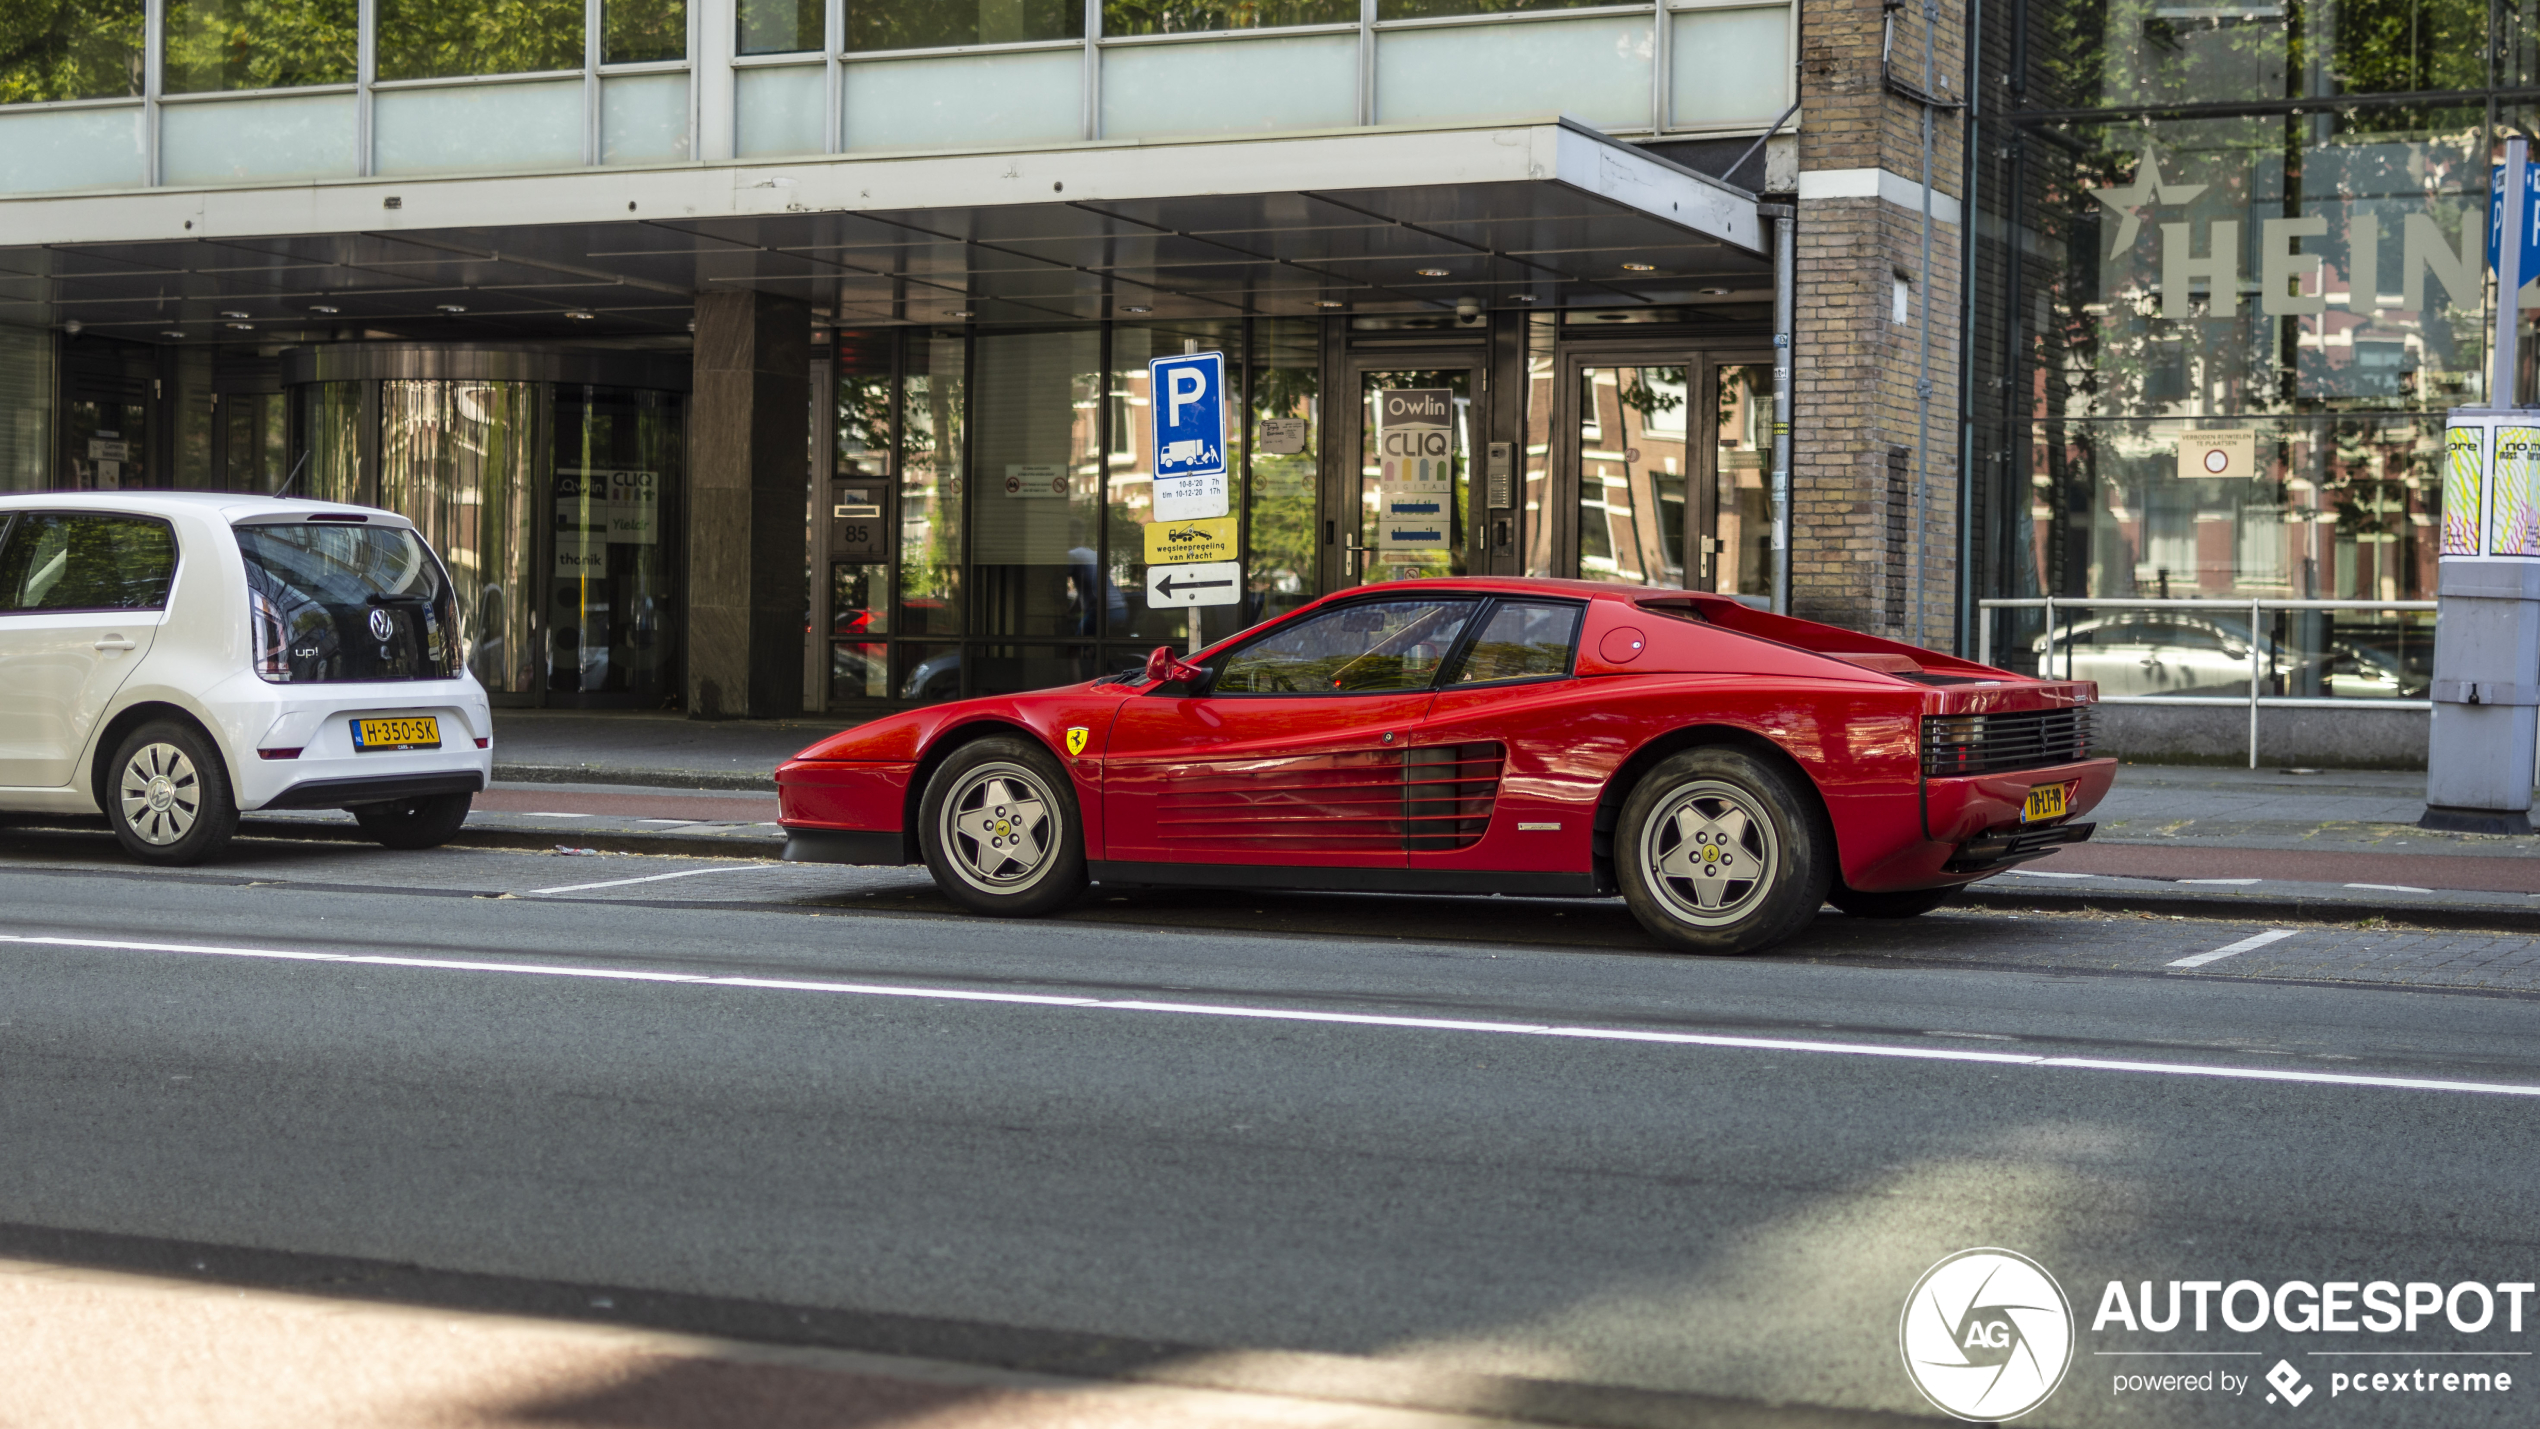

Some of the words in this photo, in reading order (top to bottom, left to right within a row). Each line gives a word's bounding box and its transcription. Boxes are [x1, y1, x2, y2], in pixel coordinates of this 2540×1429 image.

[2159, 210, 2540, 318] HEIN
[1168, 366, 1207, 428] P
[1388, 394, 1446, 416] Owlin
[1385, 432, 1447, 457] CLIQ
[2505, 442, 2527, 451] no
[612, 472, 653, 487] CLIQ
[1211, 478, 1220, 486] 7h
[1209, 487, 1221, 496] 17h
[845, 525, 869, 543] 85
[1156, 541, 1225, 554] wegsleepregeling
[559, 552, 602, 566] thonik
[295, 646, 319, 659] up!
[355, 735, 363, 743] NL
[365, 720, 435, 743] H-350-SK
[2028, 787, 2061, 816] TB-LT-19
